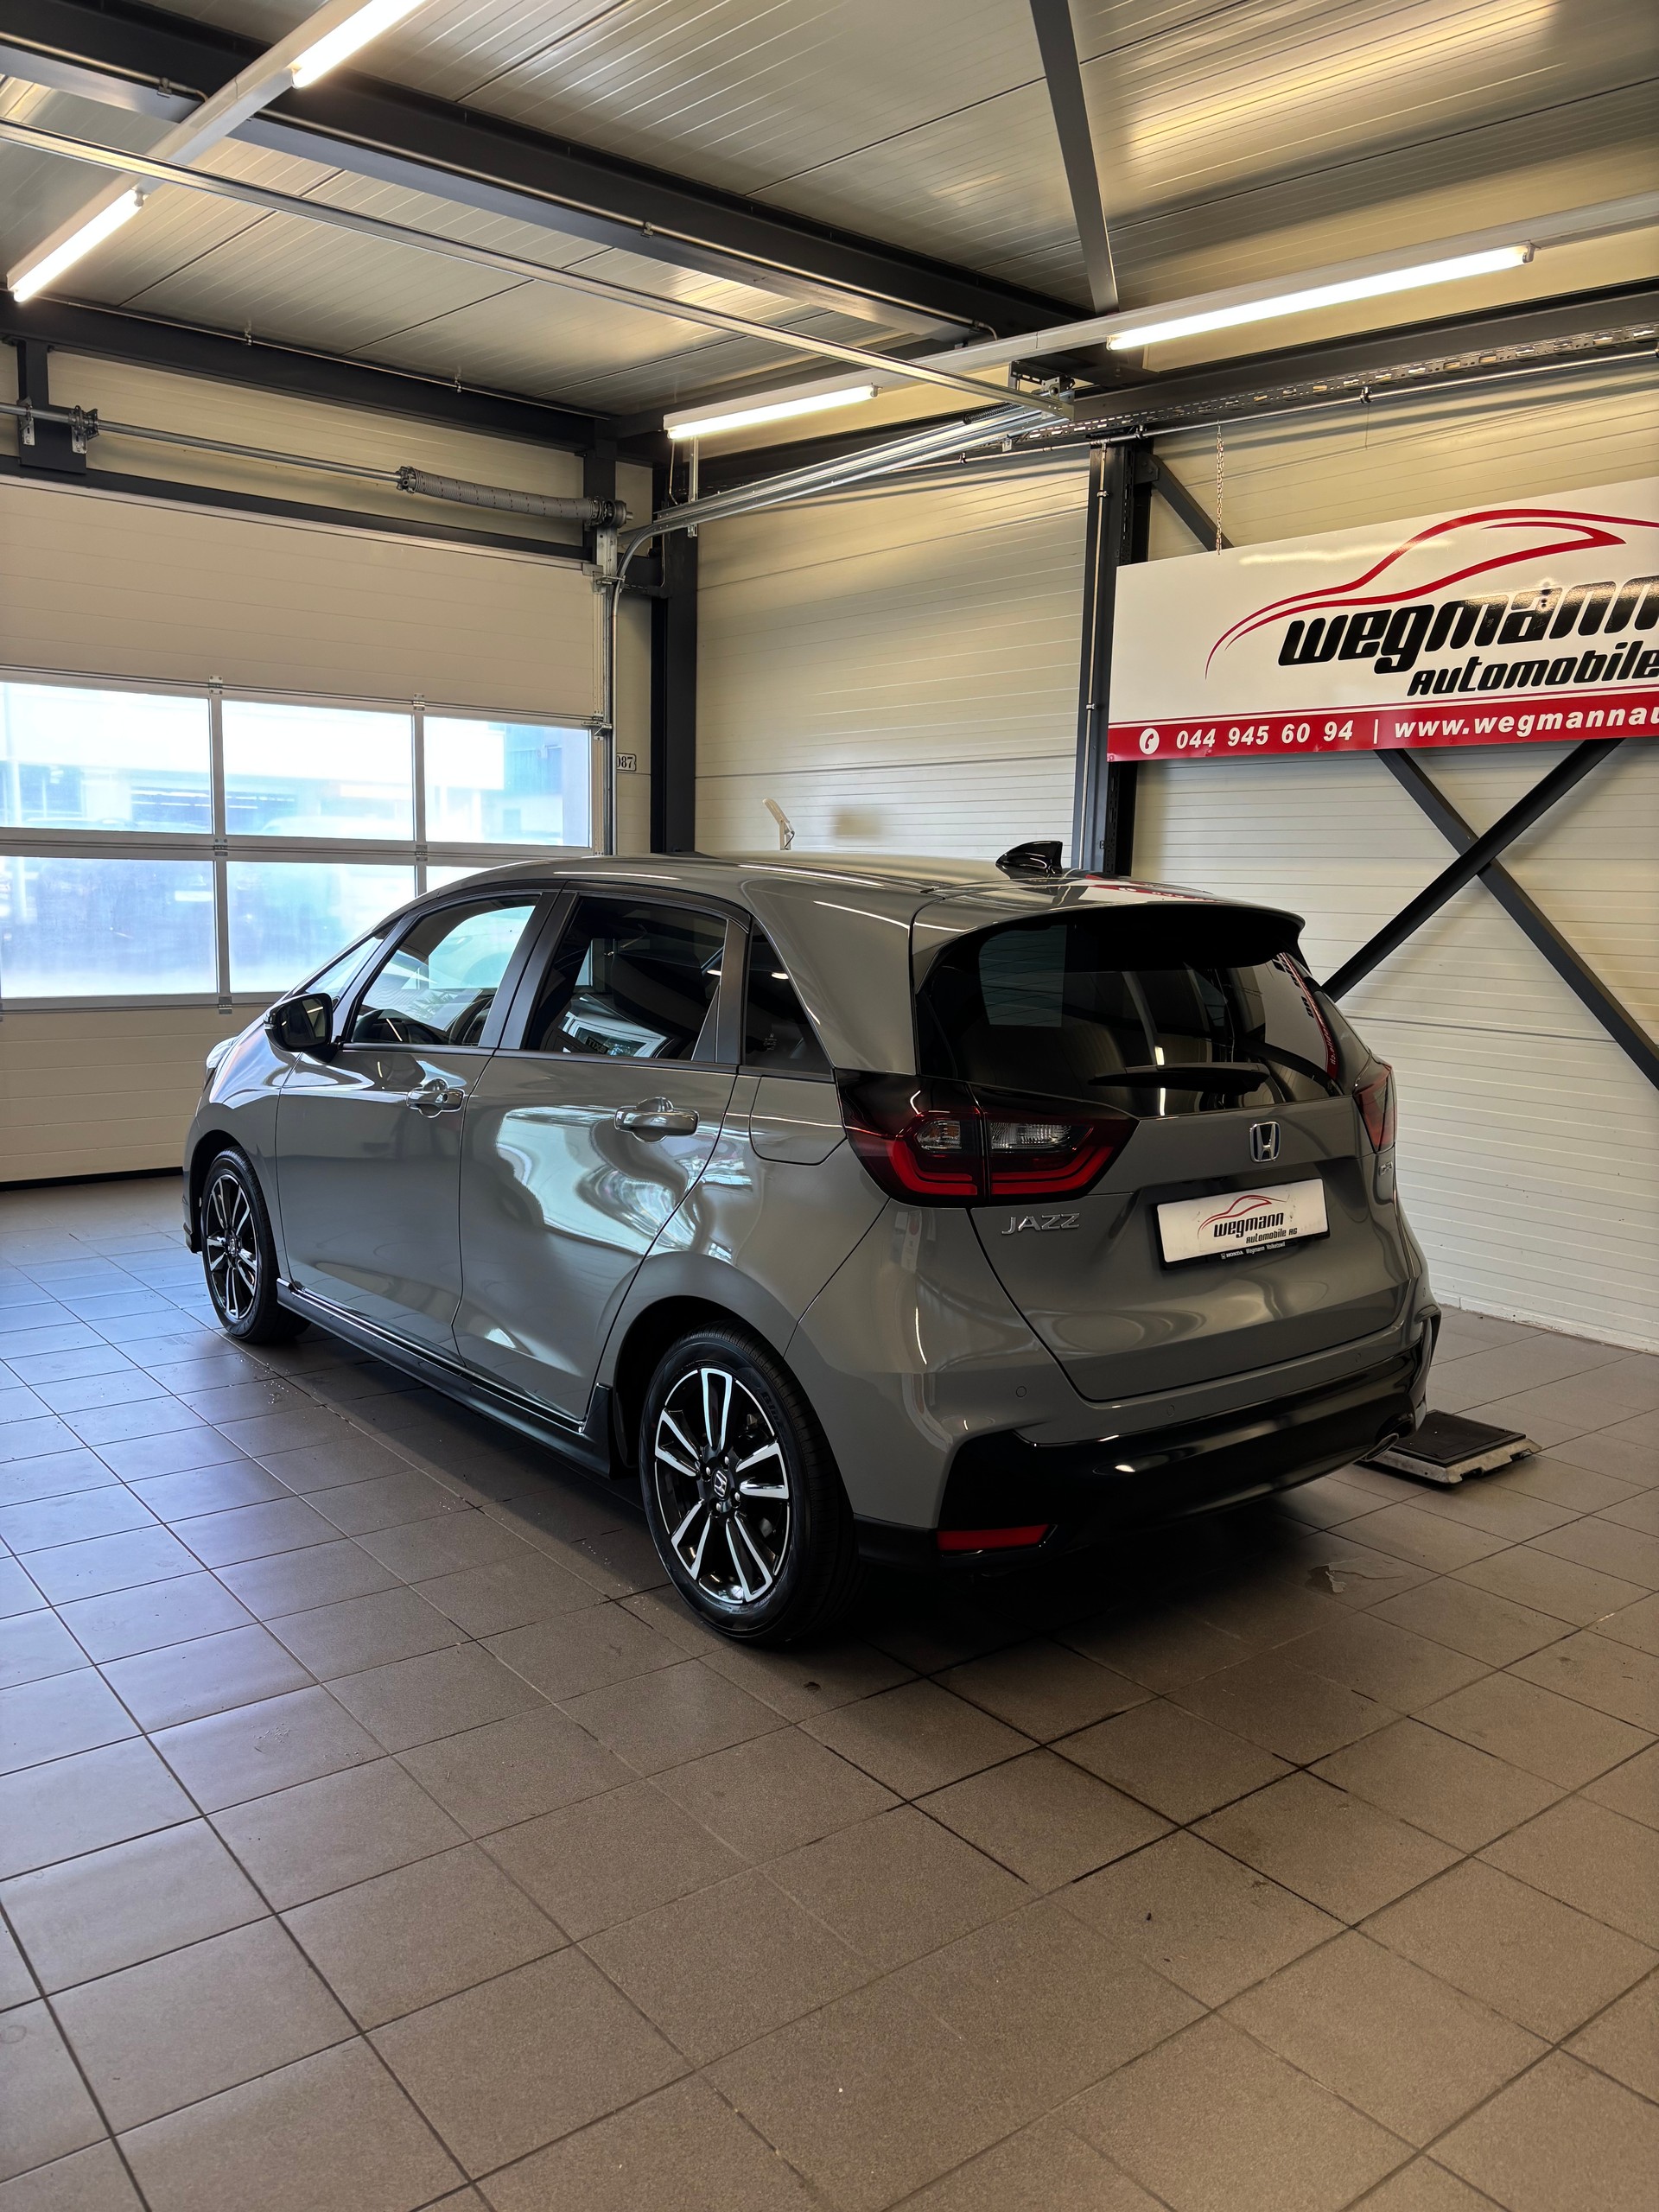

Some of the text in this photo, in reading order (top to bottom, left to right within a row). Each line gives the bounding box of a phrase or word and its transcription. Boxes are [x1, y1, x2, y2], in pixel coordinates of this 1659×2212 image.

[1278, 575, 1659, 674] wegmann
[1176, 728, 1216, 749] 044
[1228, 726, 1269, 747] 945
[1281, 722, 1311, 744] 60
[1323, 720, 1354, 741] 94
[1001, 1212, 1080, 1235] JAZZ
[1213, 1212, 1284, 1238] wegmann
